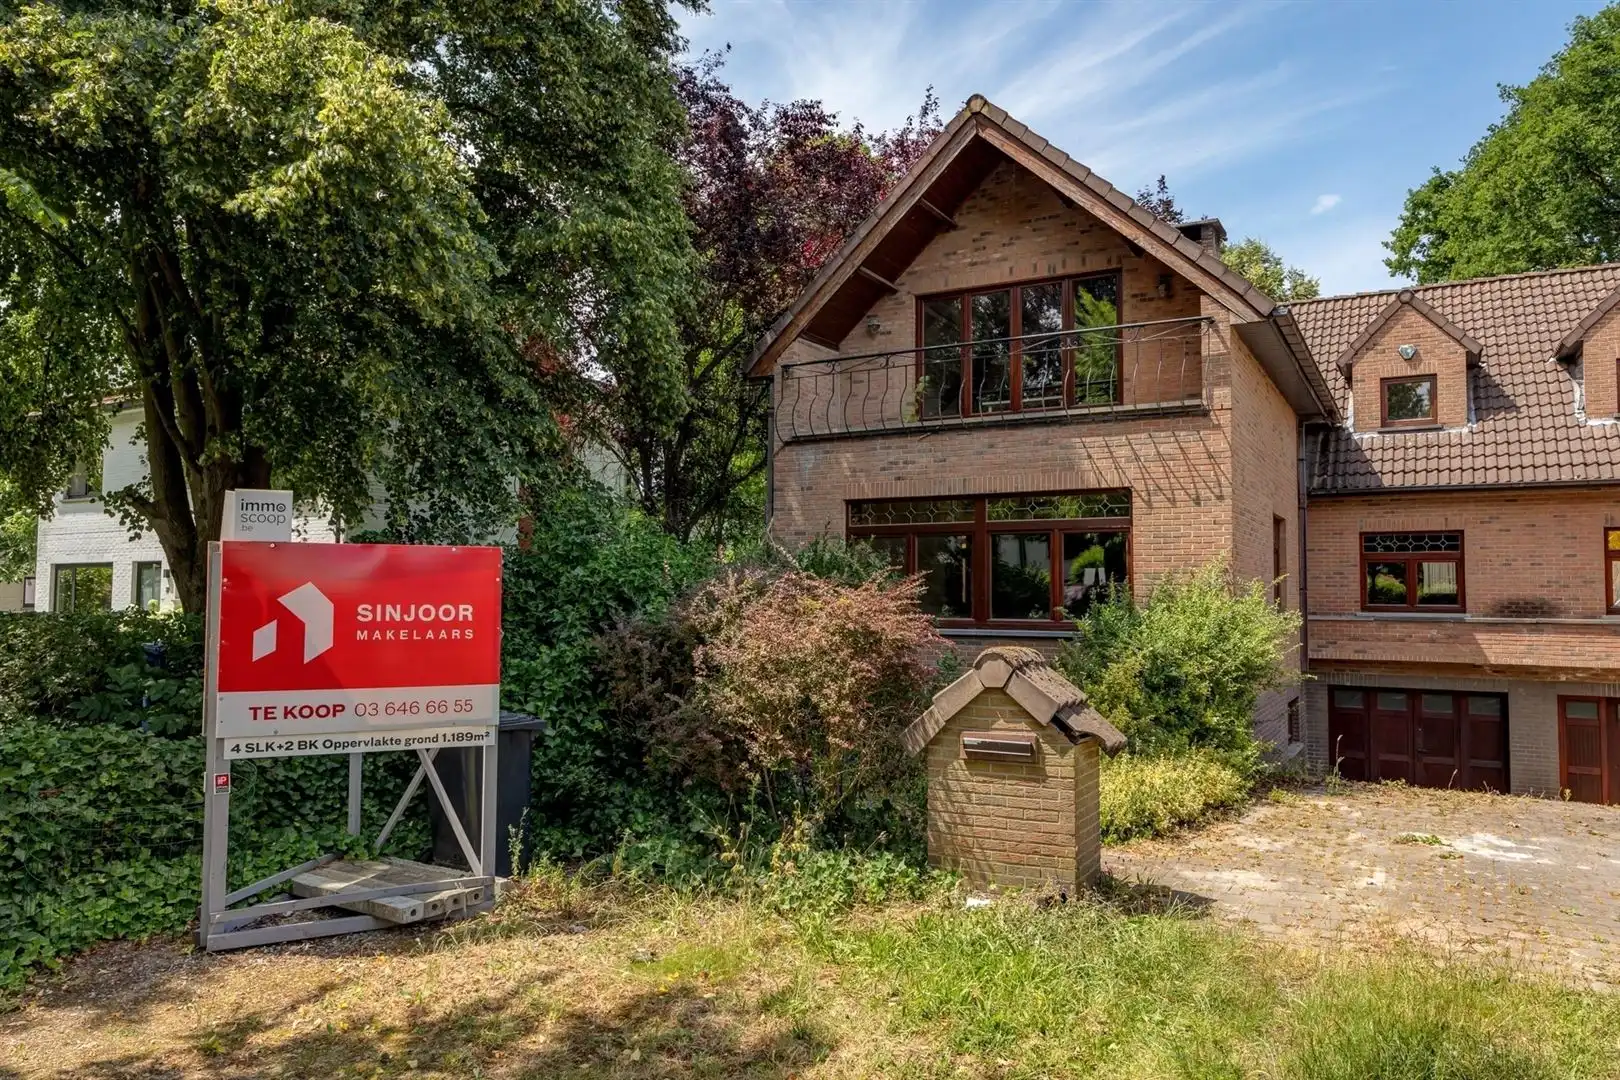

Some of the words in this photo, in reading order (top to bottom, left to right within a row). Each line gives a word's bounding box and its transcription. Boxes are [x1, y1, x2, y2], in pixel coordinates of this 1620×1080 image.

[240, 498, 286, 512] immo
[240, 513, 286, 526] scoop
[356, 604, 474, 622] SINJOOR
[356, 629, 474, 640] MAKELAARS
[249, 706, 277, 721] TE
[284, 704, 346, 720] KOOP
[354, 702, 378, 717] 03
[384, 702, 420, 716] 646
[426, 700, 448, 714] 66
[454, 699, 473, 713] 55
[230, 743, 242, 754] 4
[245, 740, 294, 753] SLK+2
[298, 739, 319, 750] BK
[324, 736, 402, 751] Oppervlakte
[404, 734, 439, 748] grond
